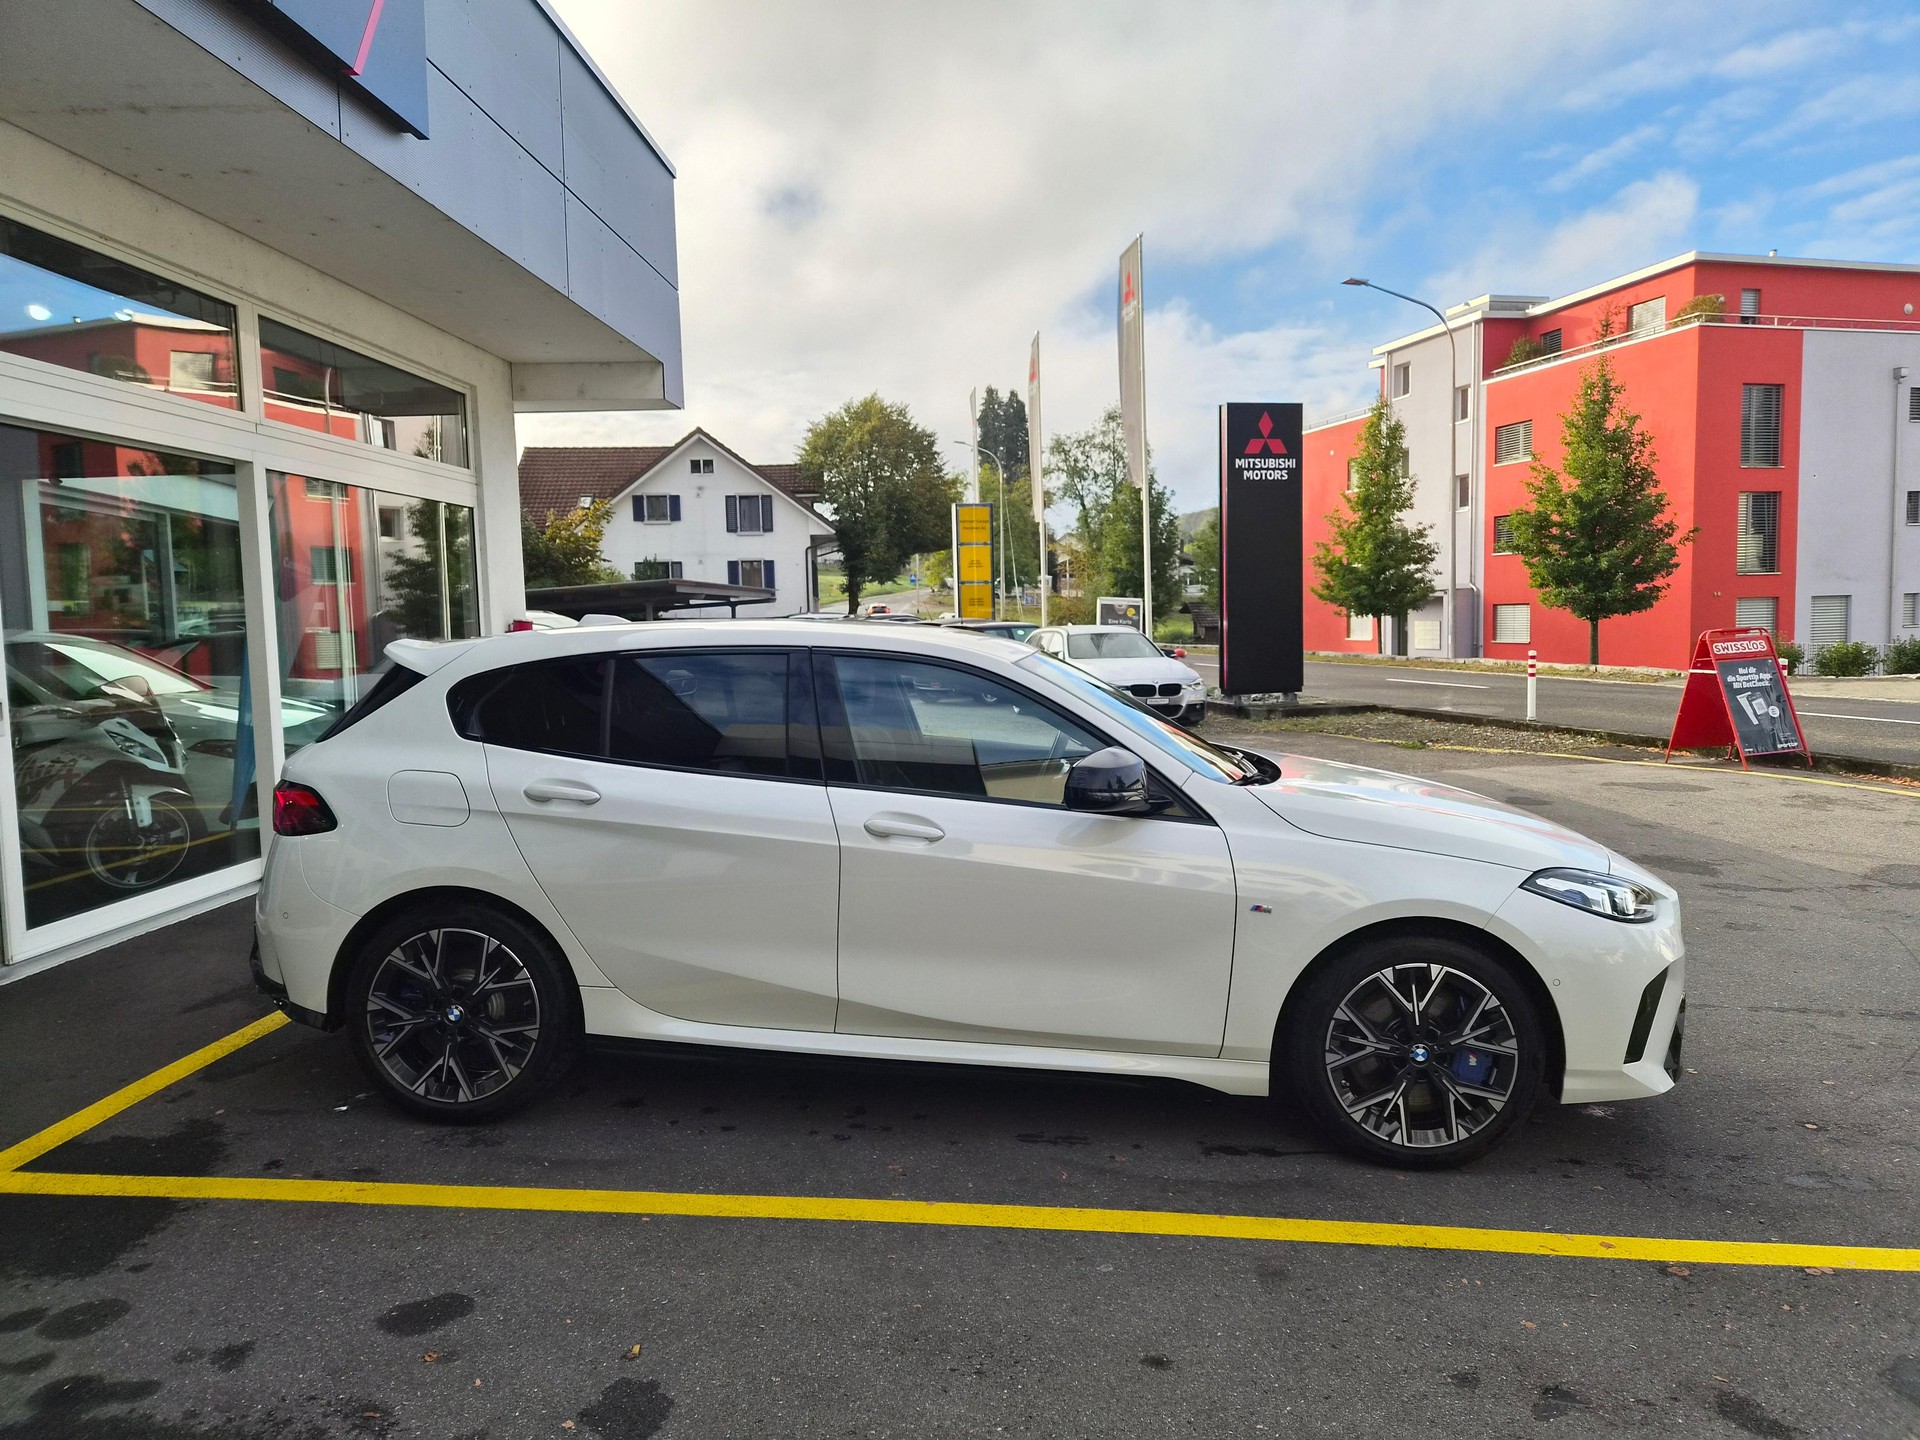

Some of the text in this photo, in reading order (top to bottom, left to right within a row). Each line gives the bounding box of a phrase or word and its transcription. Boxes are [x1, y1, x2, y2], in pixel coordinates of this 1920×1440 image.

[1235, 458, 1296, 469] MITSUBISHI
[1243, 470, 1288, 480] MOTORS
[1714, 641, 1766, 653] SWISSLOS
[1748, 666, 1757, 674] dir
[1727, 674, 1736, 682] die
[1732, 681, 1743, 689] Mit
